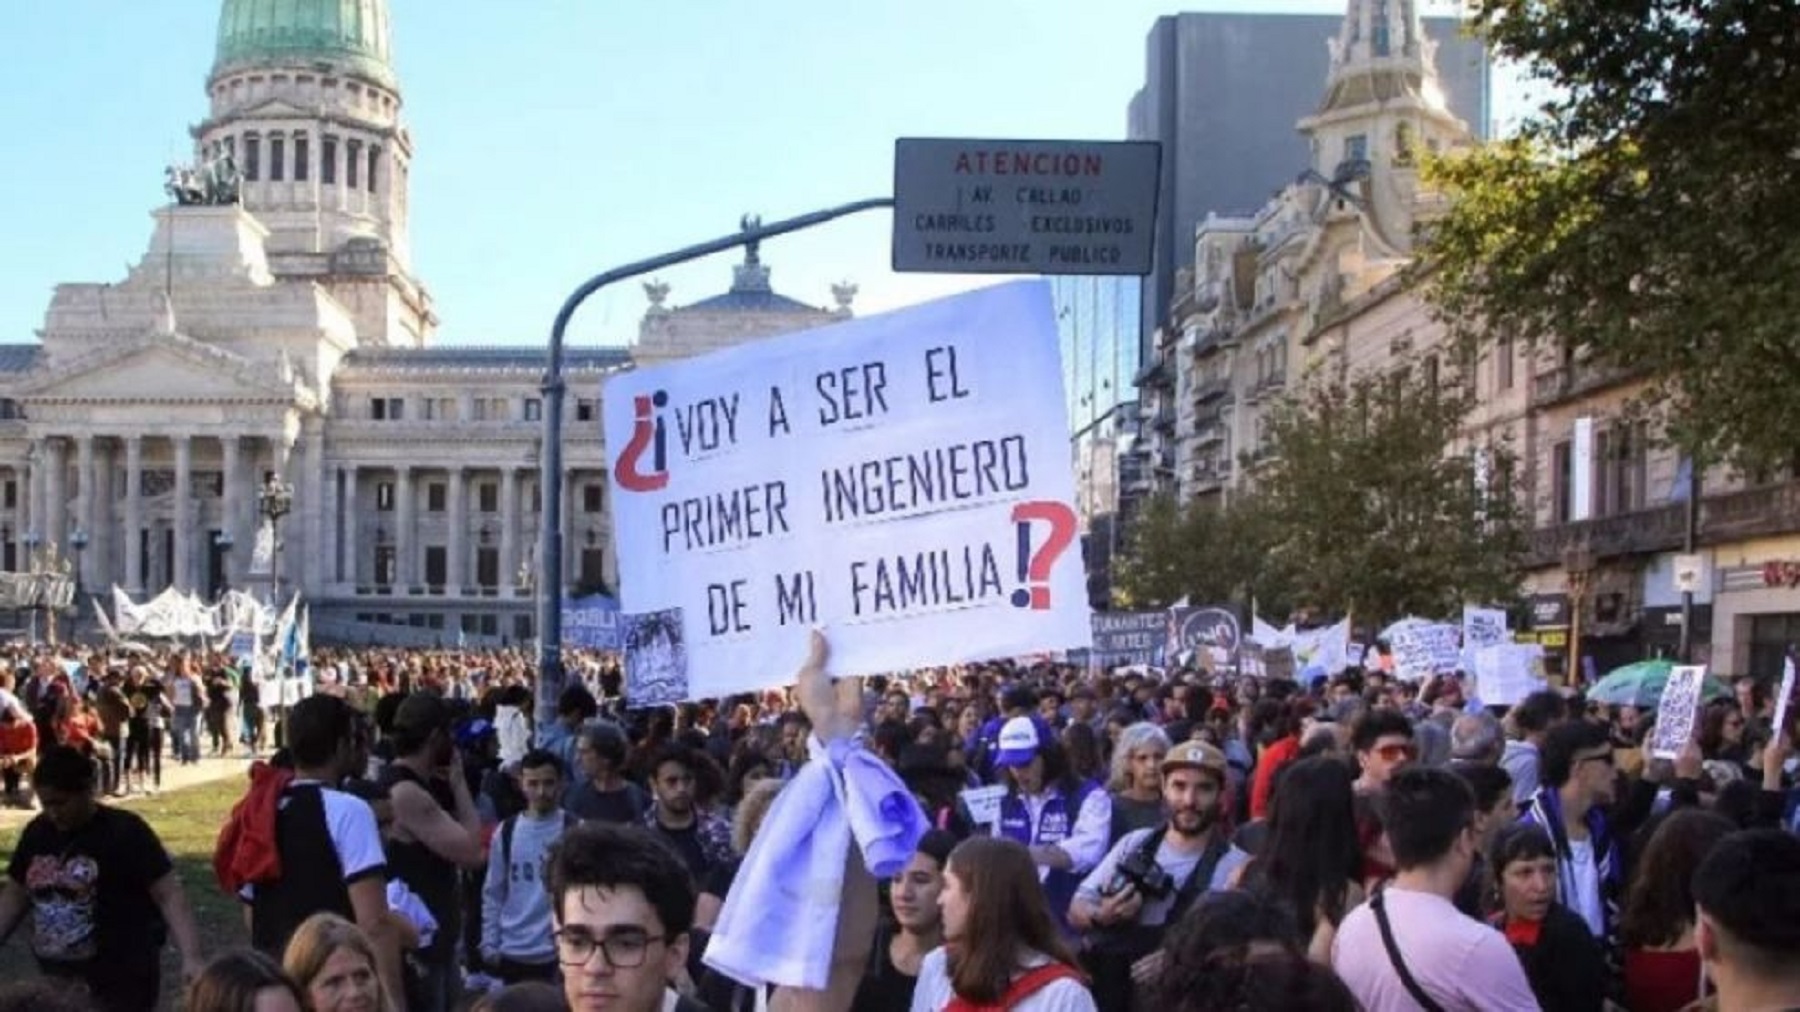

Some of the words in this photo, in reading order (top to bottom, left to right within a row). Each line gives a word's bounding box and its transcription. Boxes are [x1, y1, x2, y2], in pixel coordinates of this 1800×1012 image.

[954, 151, 1103, 176] ATENCION
[1016, 188, 1081, 206] CALLAO
[915, 213, 996, 232] CARRILES
[1031, 215, 1134, 234] EXCLUSIVOS
[924, 243, 1032, 262] TRANSPORTE
[1050, 244, 1122, 263] PUBLICO
[769, 386, 791, 437] A
[816, 361, 889, 426] SER
[925, 345, 969, 402] EL
[661, 480, 790, 553] PRIMER
[822, 435, 1030, 522] INGENIERO
[707, 581, 751, 636] DE
[776, 571, 818, 626] MI
